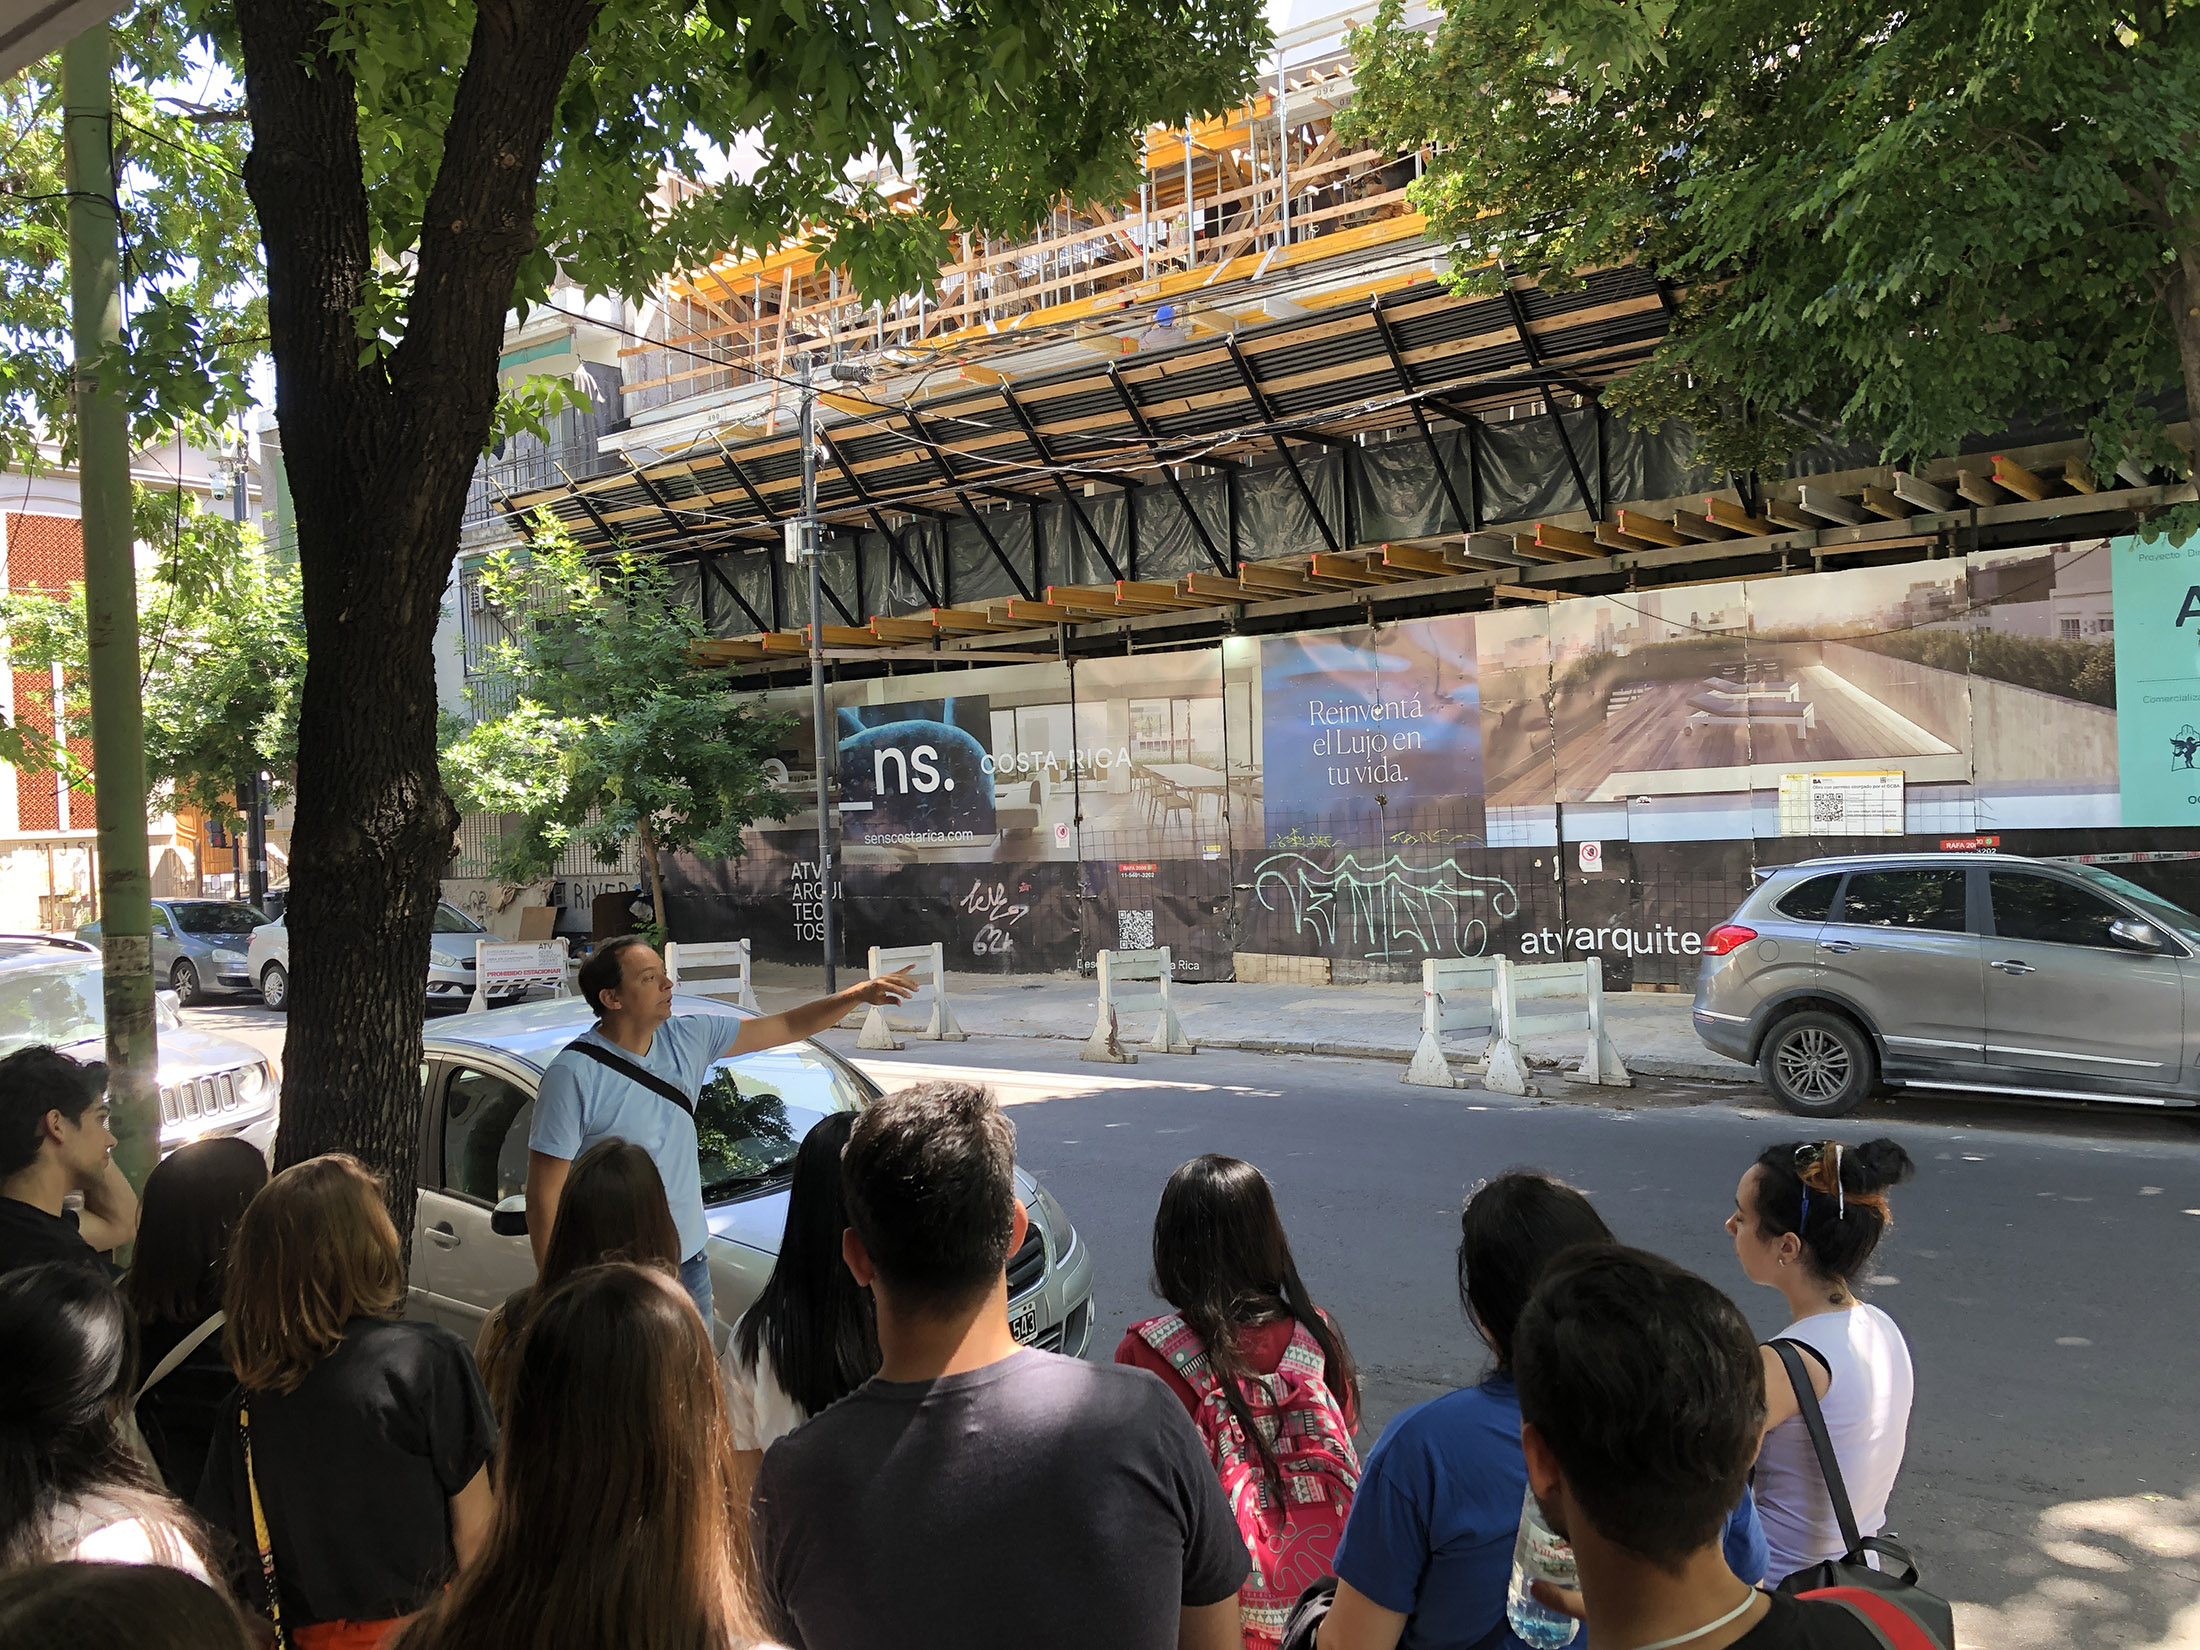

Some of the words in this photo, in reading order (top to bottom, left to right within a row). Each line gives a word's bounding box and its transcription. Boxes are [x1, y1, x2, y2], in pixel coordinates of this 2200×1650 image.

[2138, 551, 2181, 562] Proyecto
[1309, 691, 1424, 726] Reinventá
[1313, 728, 1331, 756] el
[1336, 728, 1388, 760] Lujo
[1392, 730, 1422, 751] en
[980, 750, 1059, 775] COSTA
[1069, 746, 1133, 770] RICA
[1327, 766, 1350, 786] tu
[1354, 755, 1409, 784] vida.
[864, 829, 974, 845] senscostarica.com
[791, 861, 822, 880] ATV
[793, 922, 825, 941] TOS
[523, 968, 561, 976] ESTACIONAR
[1178, 960, 1200, 970] Rica
